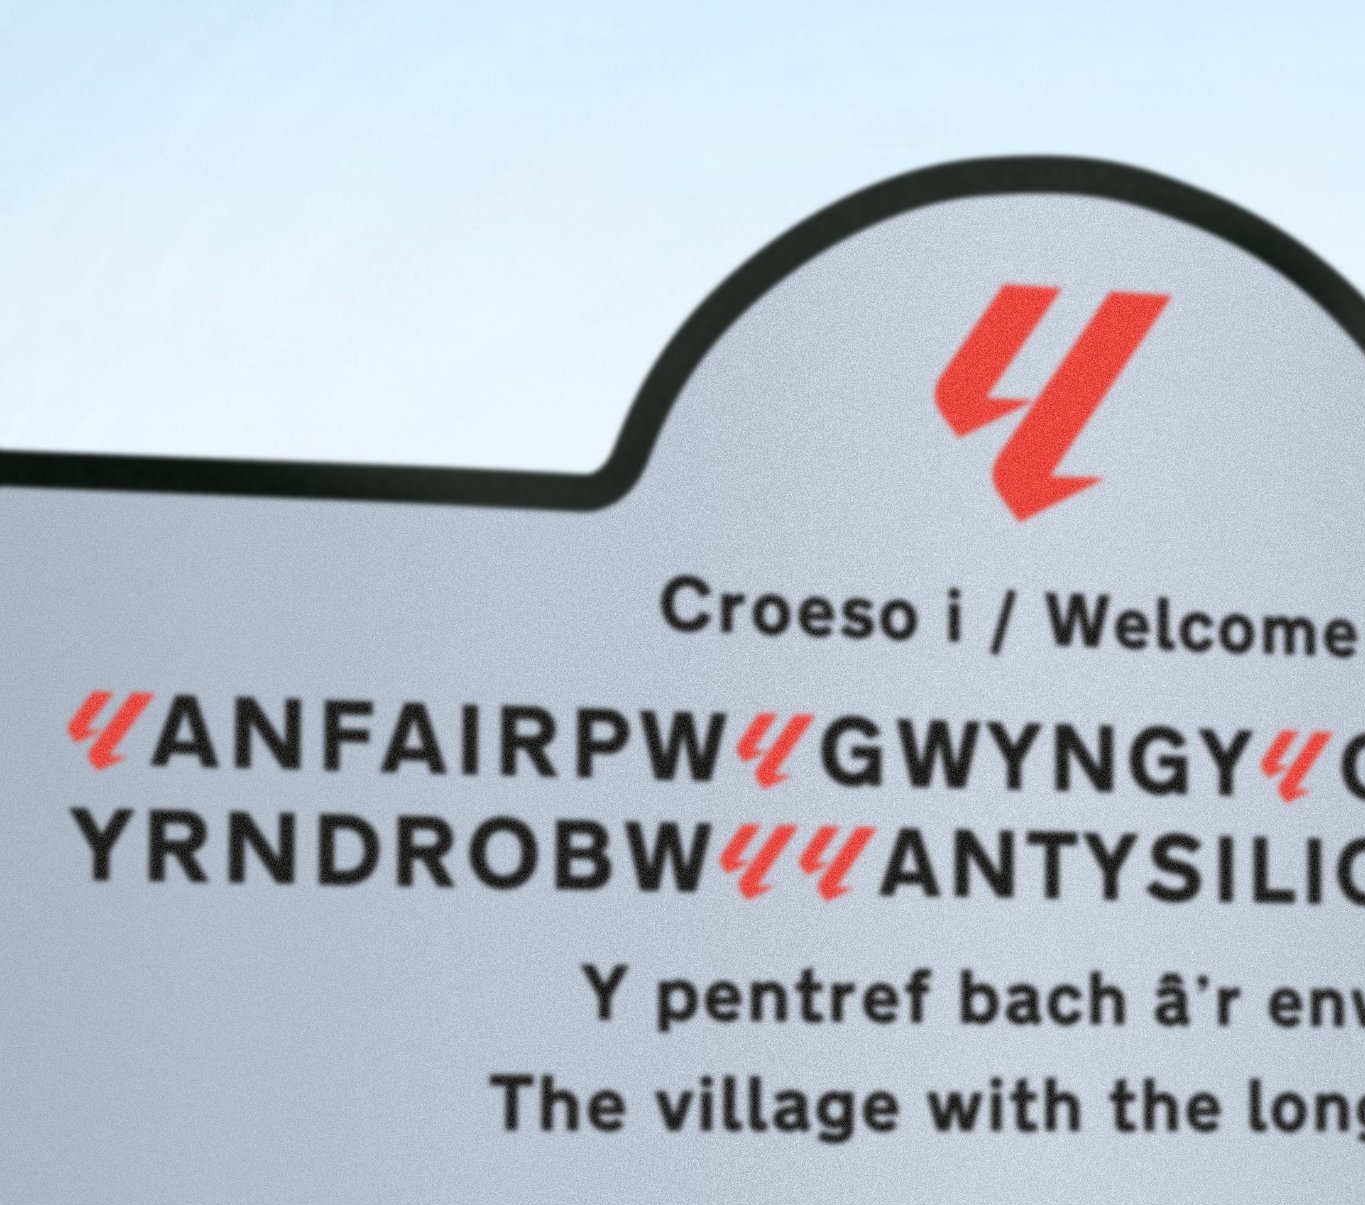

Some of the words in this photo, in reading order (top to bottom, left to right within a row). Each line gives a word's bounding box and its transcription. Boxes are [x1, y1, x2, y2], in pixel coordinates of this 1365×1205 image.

[661, 575, 917, 641] Croeso
[948, 589, 961, 641] i
[990, 591, 1016, 654] /
[1046, 593, 1357, 660] Welcome
[583, 964, 628, 1020] Y
[658, 969, 931, 1032] pentref
[961, 970, 1125, 1026] bach
[490, 1074, 625, 1132] The
[656, 1076, 898, 1144] village
[928, 1078, 1080, 1132] with
[1110, 1079, 1220, 1132] the
